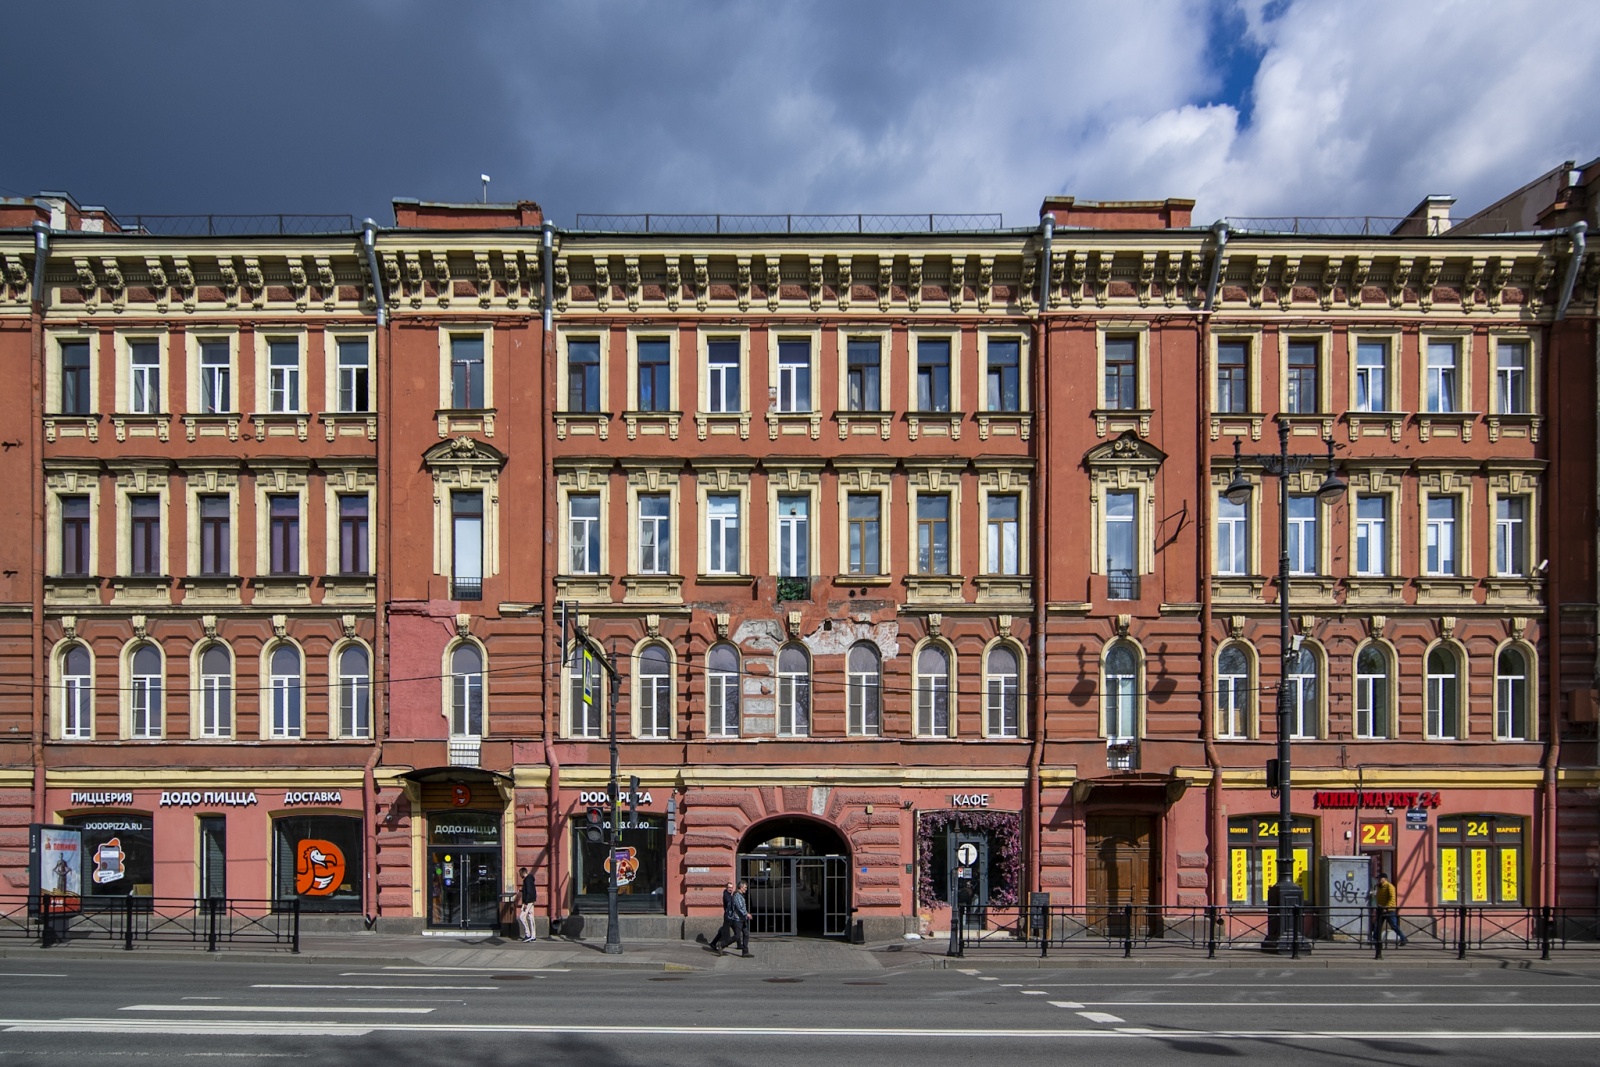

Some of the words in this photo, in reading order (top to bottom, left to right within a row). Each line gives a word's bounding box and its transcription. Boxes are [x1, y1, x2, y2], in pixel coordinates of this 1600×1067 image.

[71, 792, 132, 804] ПИЦЦЕРИЯ
[160, 791, 201, 805] ДОДО
[204, 791, 257, 805] ПИЦЦА
[284, 792, 341, 803] ДОСТАВКА
[618, 791, 652, 803] PIZA
[953, 793, 989, 806] КАФЕ
[1317, 792, 1358, 806] МИНИ
[1361, 791, 1419, 807] МАРКЕТ
[1422, 791, 1441, 807] 24
[85, 822, 143, 830] DODOPIZZA.RU
[434, 825, 462, 835] ДОДО
[463, 825, 498, 835] ПИЦЦА
[1258, 822, 1279, 836] 24
[1467, 821, 1489, 836] 24
[1362, 824, 1391, 844] 24
[1475, 850, 1483, 900] ПРОДУКТЫ
